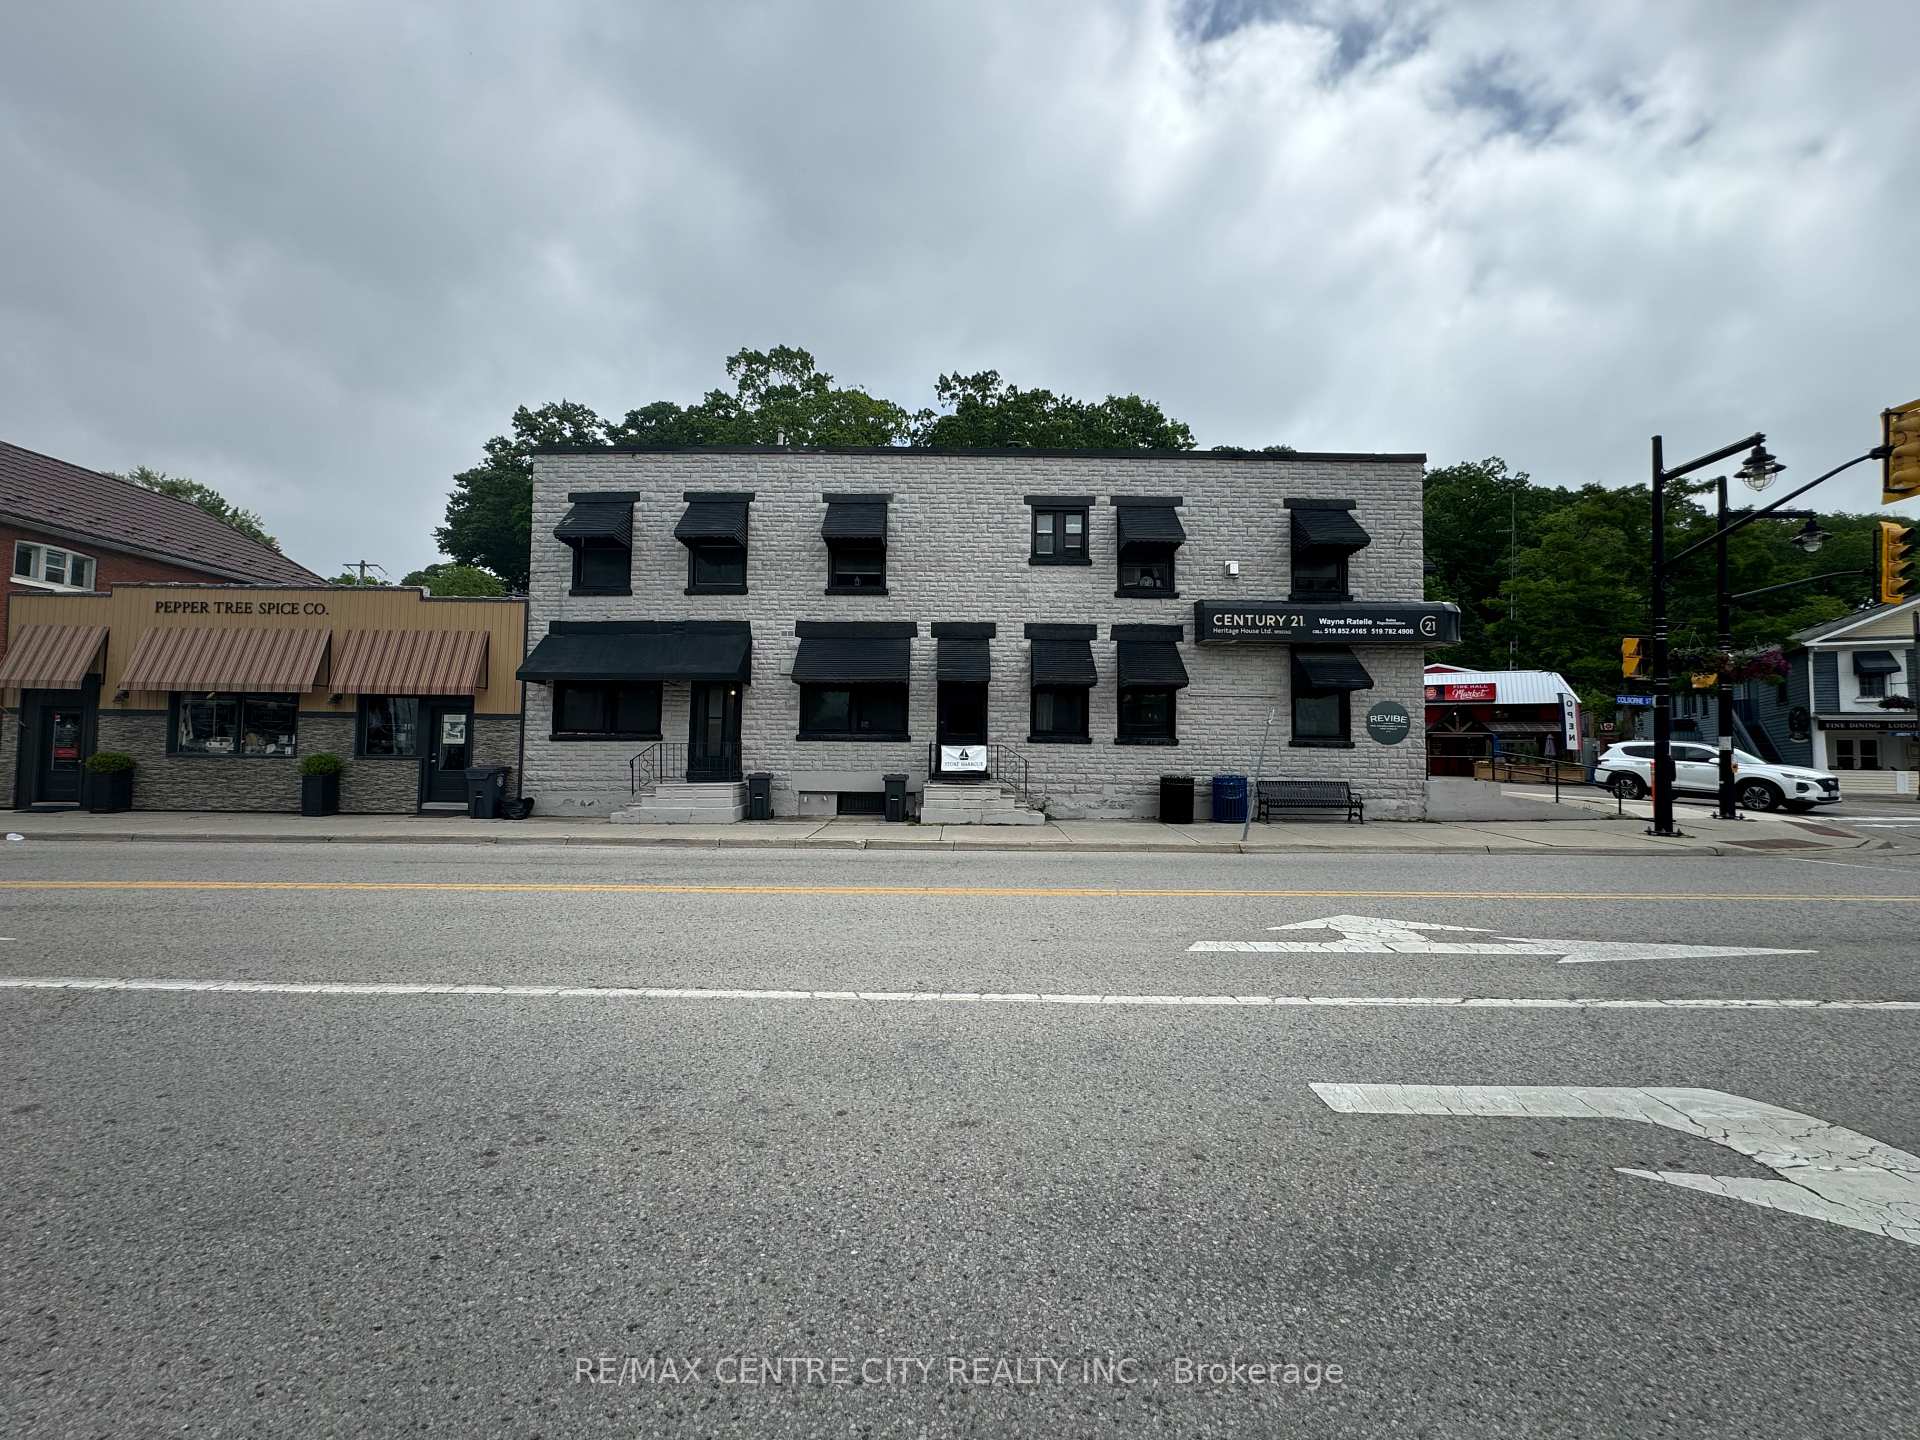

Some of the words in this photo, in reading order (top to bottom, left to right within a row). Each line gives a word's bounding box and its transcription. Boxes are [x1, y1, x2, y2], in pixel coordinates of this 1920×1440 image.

[154, 600, 210, 615] PEPPER
[213, 601, 254, 615] TREE
[258, 602, 300, 616] SPICE
[303, 602, 330, 616] CO.
[1213, 614, 1287, 627] CENTURY
[1318, 617, 1345, 627] Wayne
[1346, 617, 1373, 626] Ratelle
[1213, 627, 1240, 635] Heritage
[1451, 688, 1490, 700] Market
[1369, 714, 1408, 724] REVIBE
